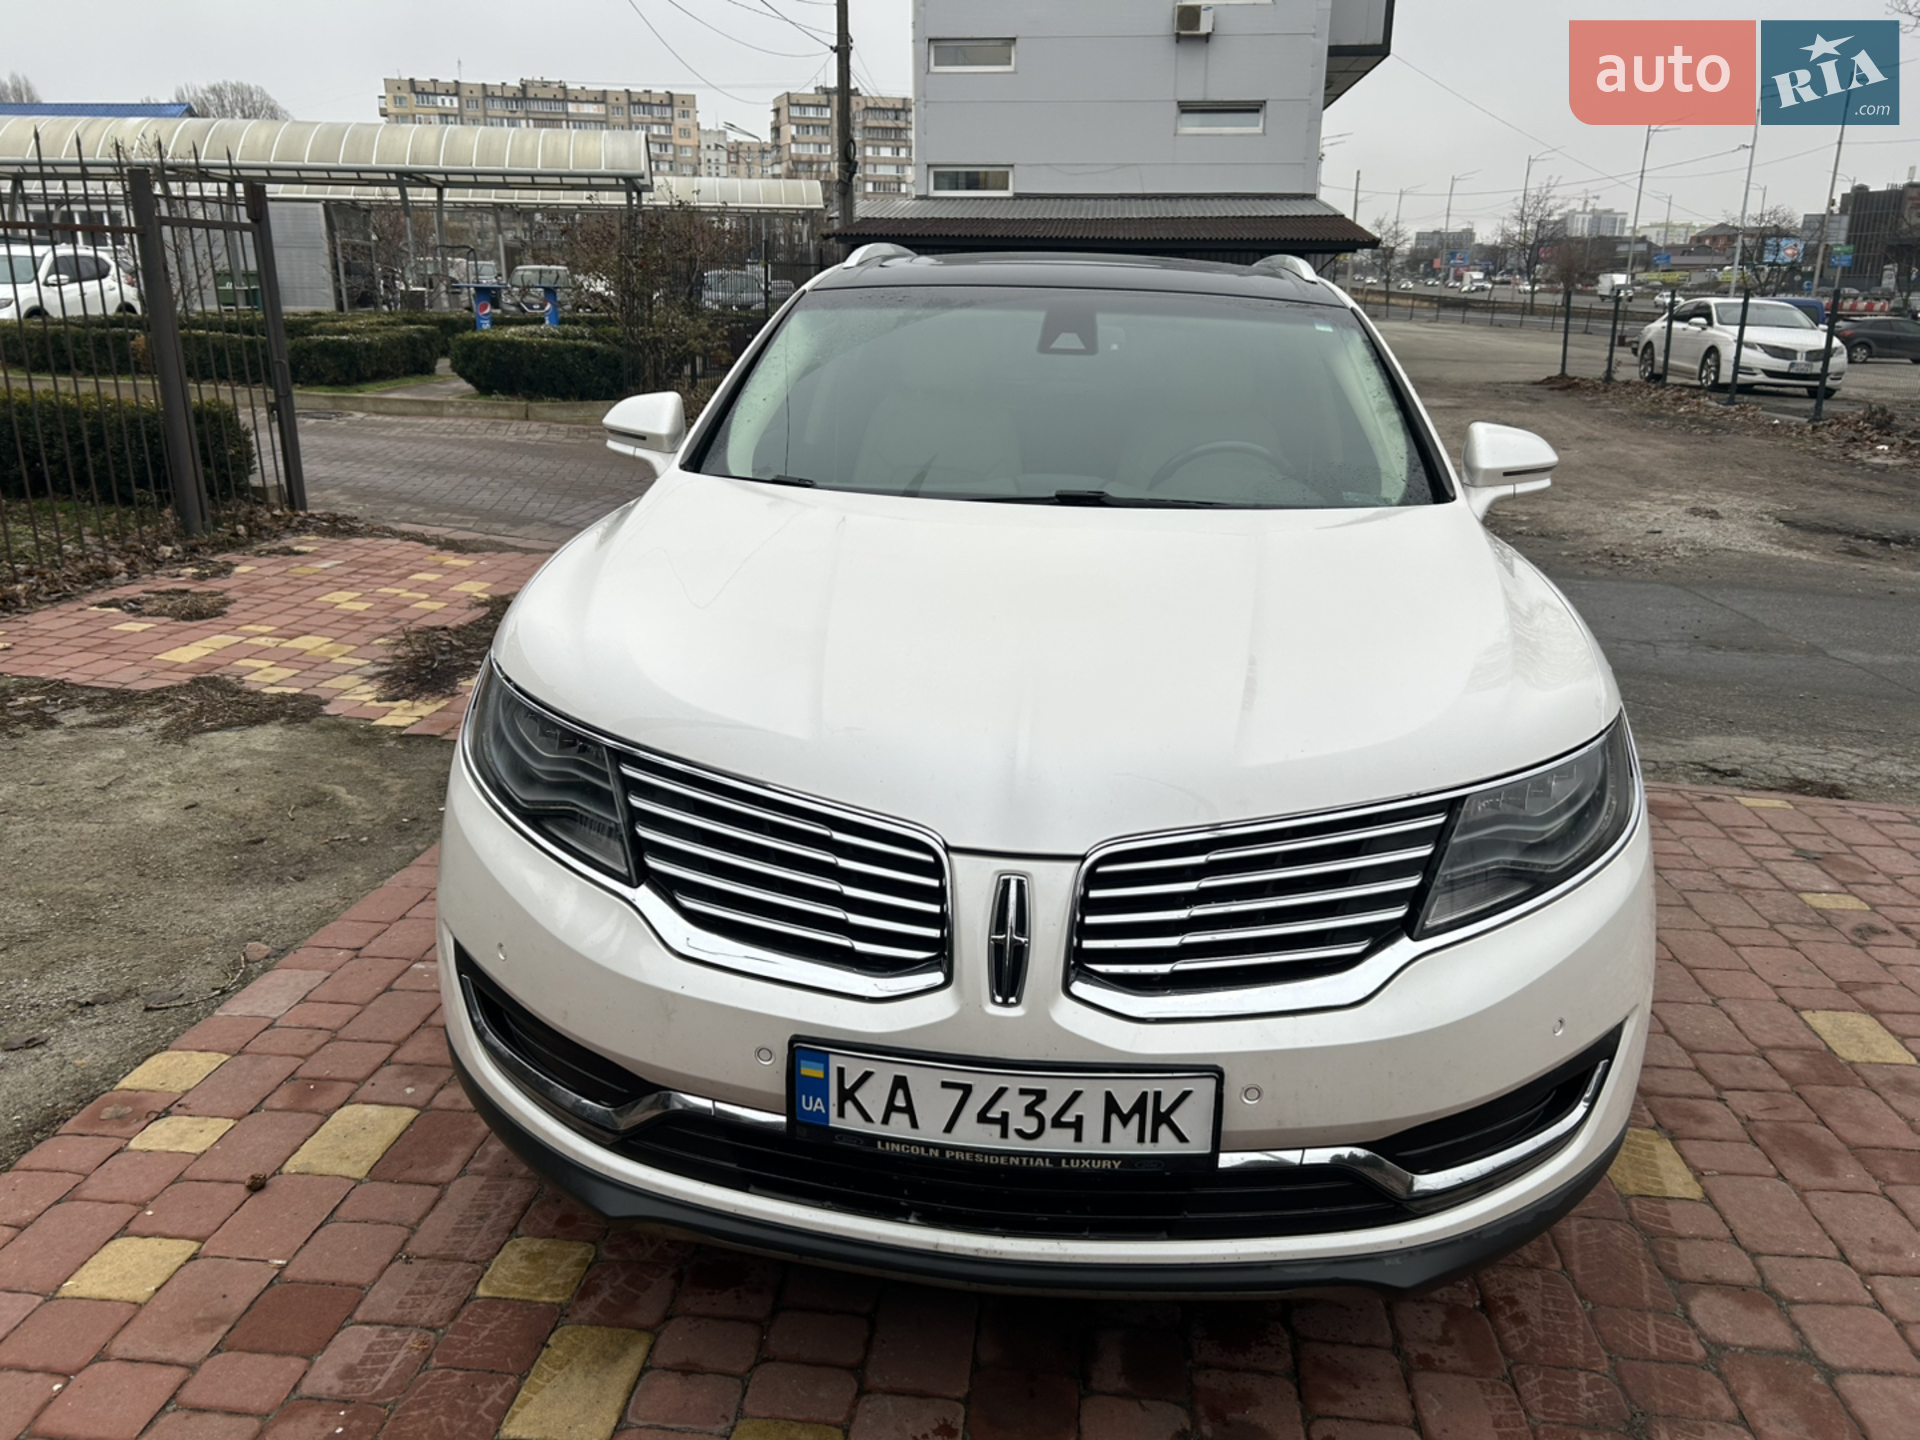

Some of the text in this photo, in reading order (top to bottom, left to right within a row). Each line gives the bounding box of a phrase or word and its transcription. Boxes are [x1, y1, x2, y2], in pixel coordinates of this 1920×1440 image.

[801, 1094, 826, 1114] UA
[836, 1065, 1194, 1144] KA 7434 MK
[877, 1140, 940, 1157] LINCOLN
[945, 1150, 1054, 1167] PRESIDENTIAL
[1061, 1158, 1123, 1169] LUXURY
